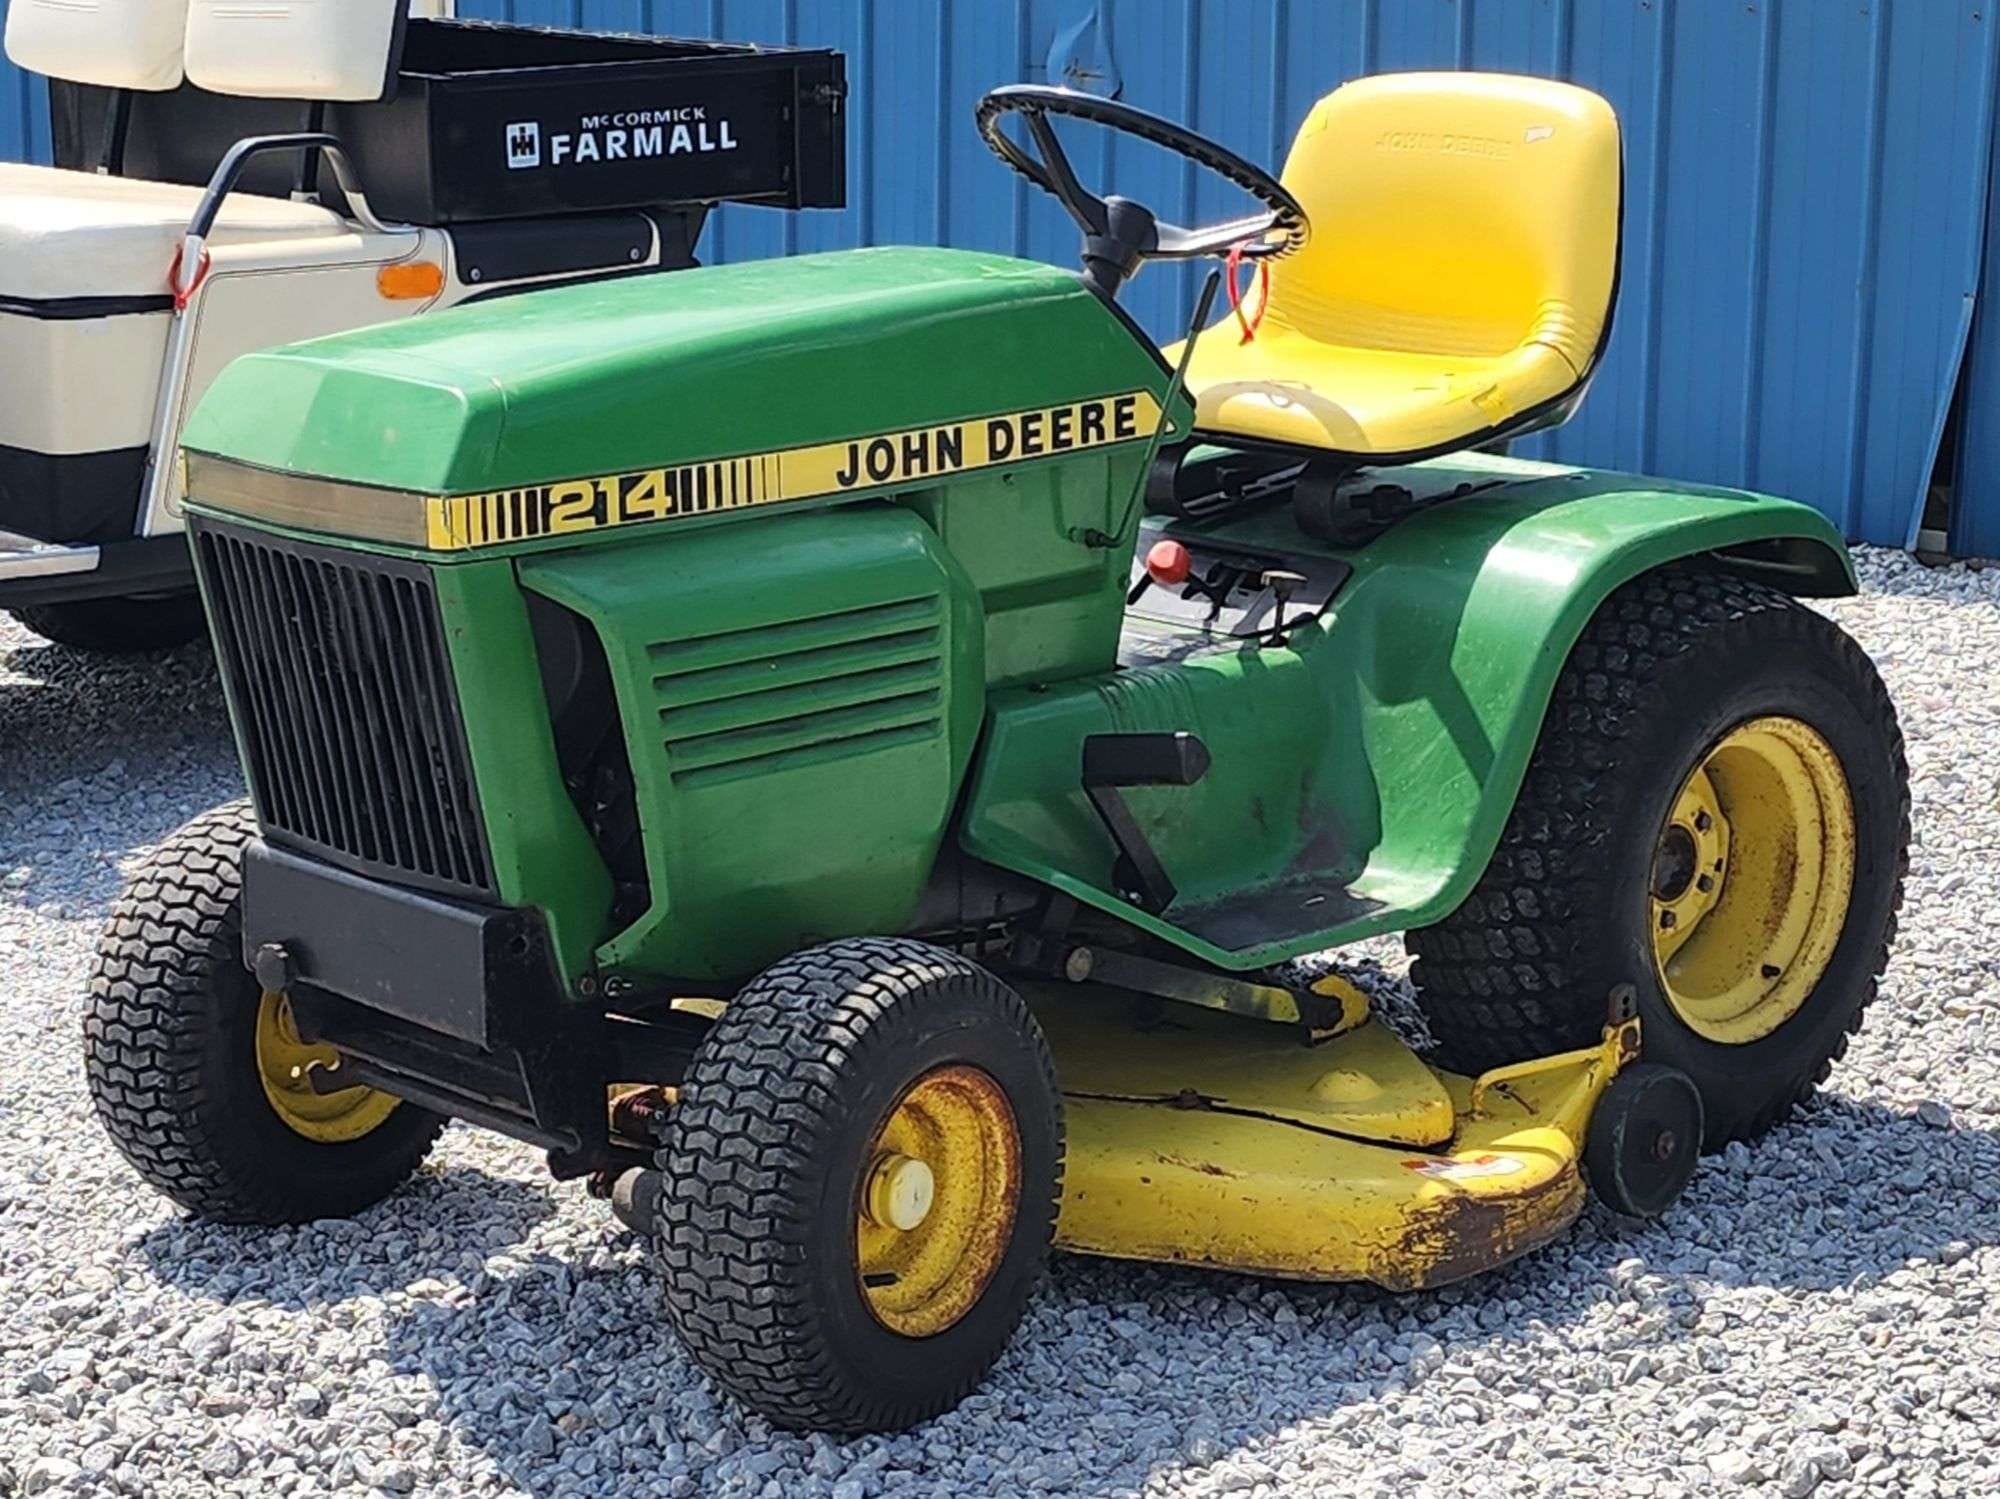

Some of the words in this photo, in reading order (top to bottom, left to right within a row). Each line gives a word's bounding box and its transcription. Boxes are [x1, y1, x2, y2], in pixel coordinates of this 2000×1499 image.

[551, 121, 737, 165] FARMALL
[836, 427, 963, 487] JOHN
[987, 396, 1136, 462] DEERE
[549, 469, 672, 534] 214
